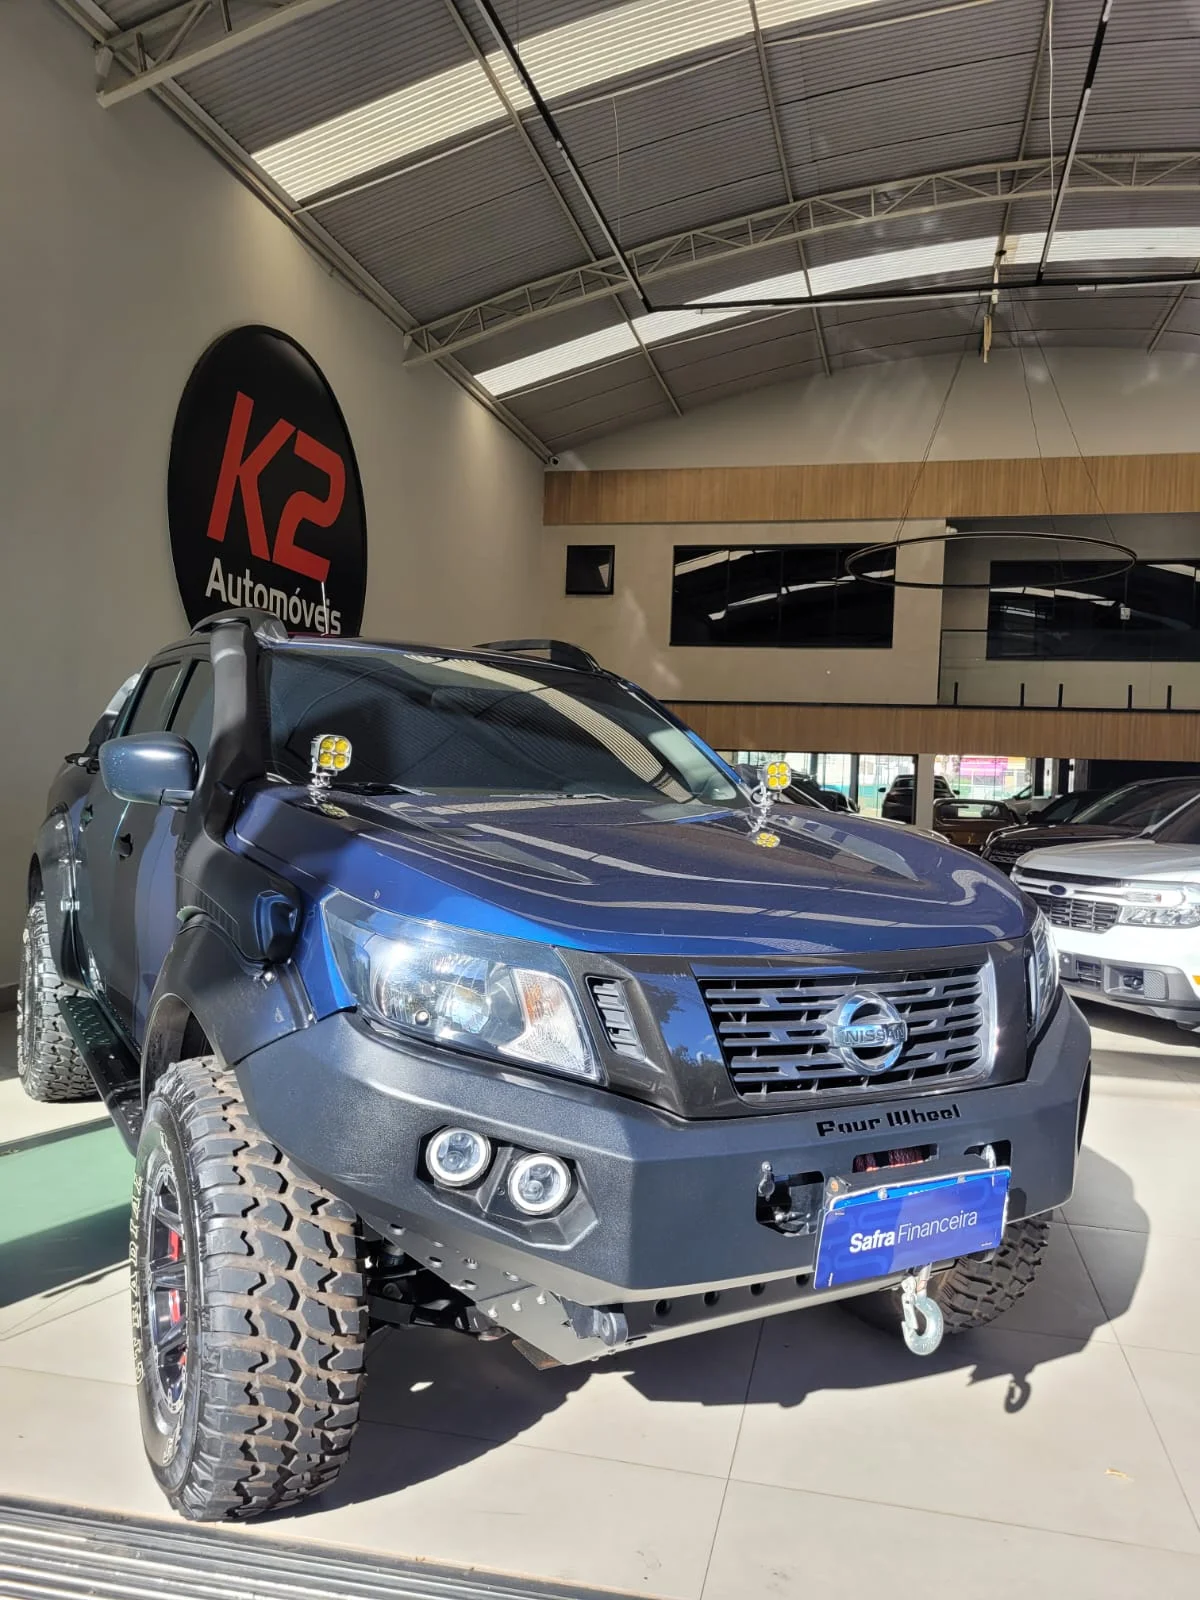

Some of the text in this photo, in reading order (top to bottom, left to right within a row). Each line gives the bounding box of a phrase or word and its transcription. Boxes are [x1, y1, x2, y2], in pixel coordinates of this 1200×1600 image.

[206, 390, 346, 583] K2
[205, 556, 342, 635] Automóveis
[845, 1024, 906, 1043] NISSAN
[815, 1103, 962, 1137] Four Wheel
[849, 1210, 979, 1253] Safra Financeira
